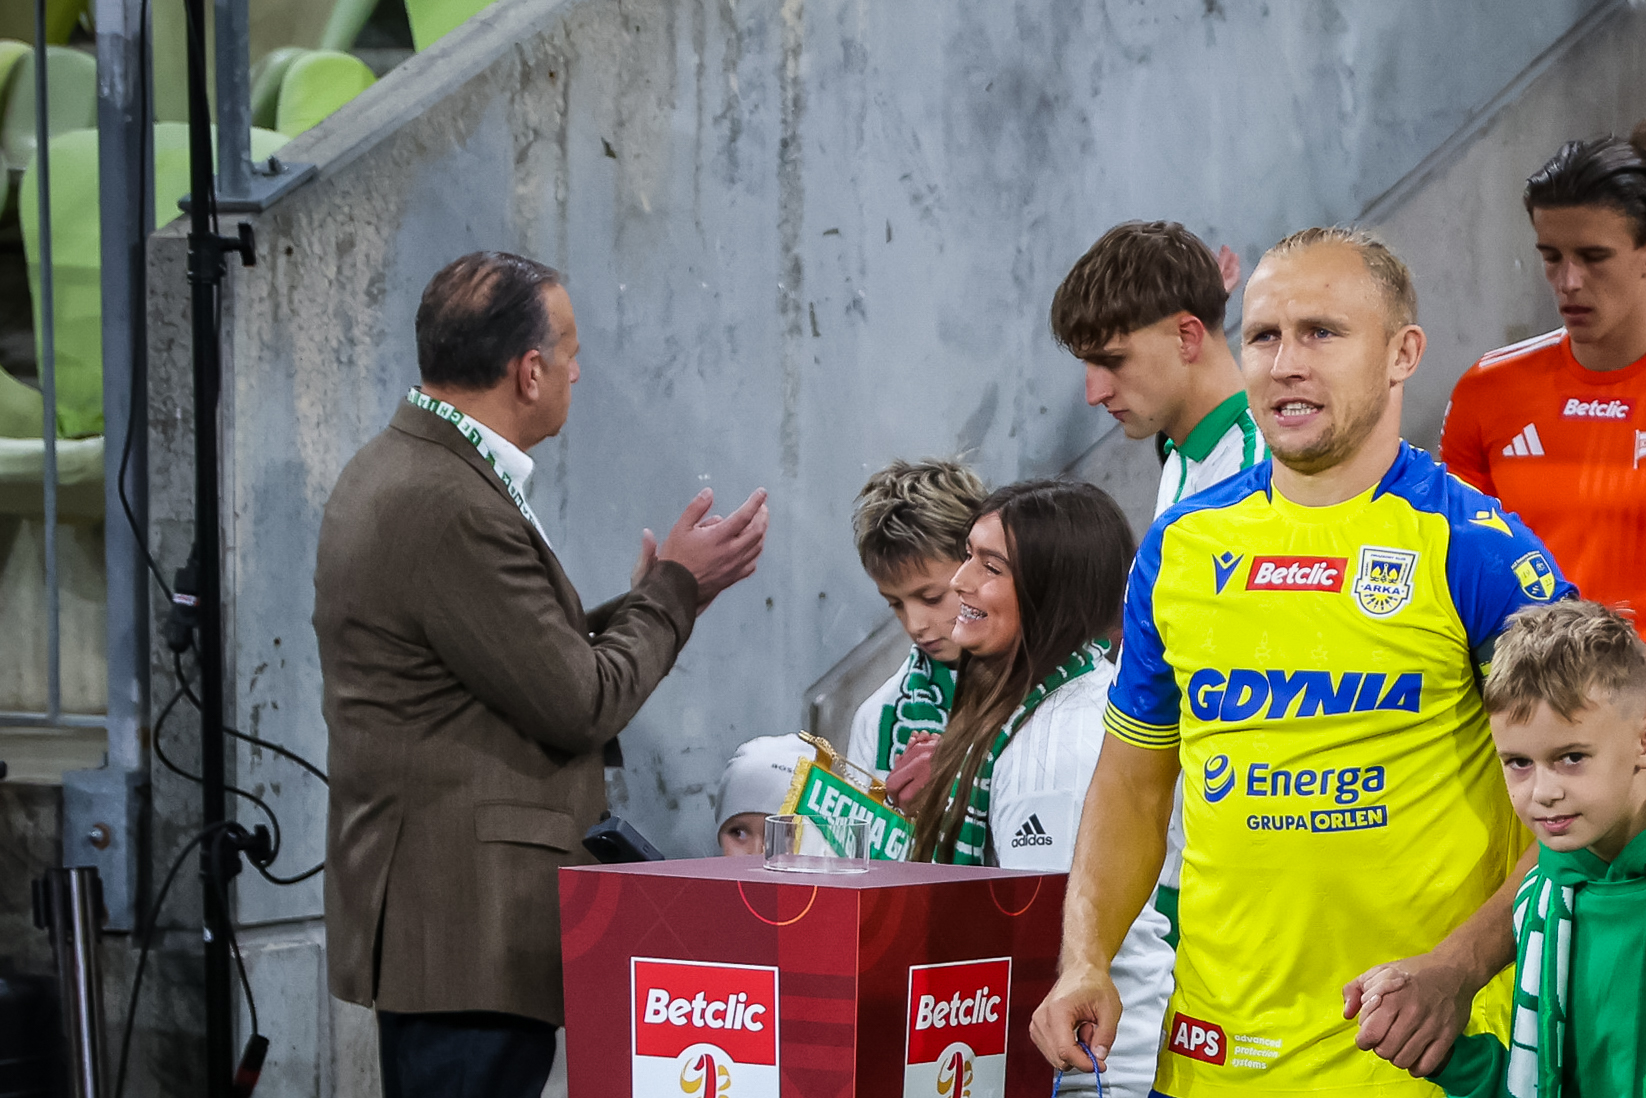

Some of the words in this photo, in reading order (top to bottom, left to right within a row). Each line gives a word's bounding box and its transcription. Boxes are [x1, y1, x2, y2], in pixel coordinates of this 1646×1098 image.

[1563, 398, 1630, 418] Betclic
[1253, 561, 1339, 586] Betclic
[1363, 584, 1401, 595] ARKA
[1187, 667, 1423, 722] GDYNIA
[1246, 762, 1385, 805] Energa
[807, 778, 887, 850] LECHIA
[1246, 814, 1308, 830] GRUPA
[1314, 807, 1383, 830] ORLEN
[1011, 833, 1053, 848] adidas
[643, 987, 767, 1032] Betclic
[915, 985, 1002, 1031] Betclic
[1174, 1021, 1220, 1057] APS
[1234, 1034, 1282, 1048] advanced
[1234, 1045, 1279, 1058] protection
[1232, 1058, 1267, 1070] systems
